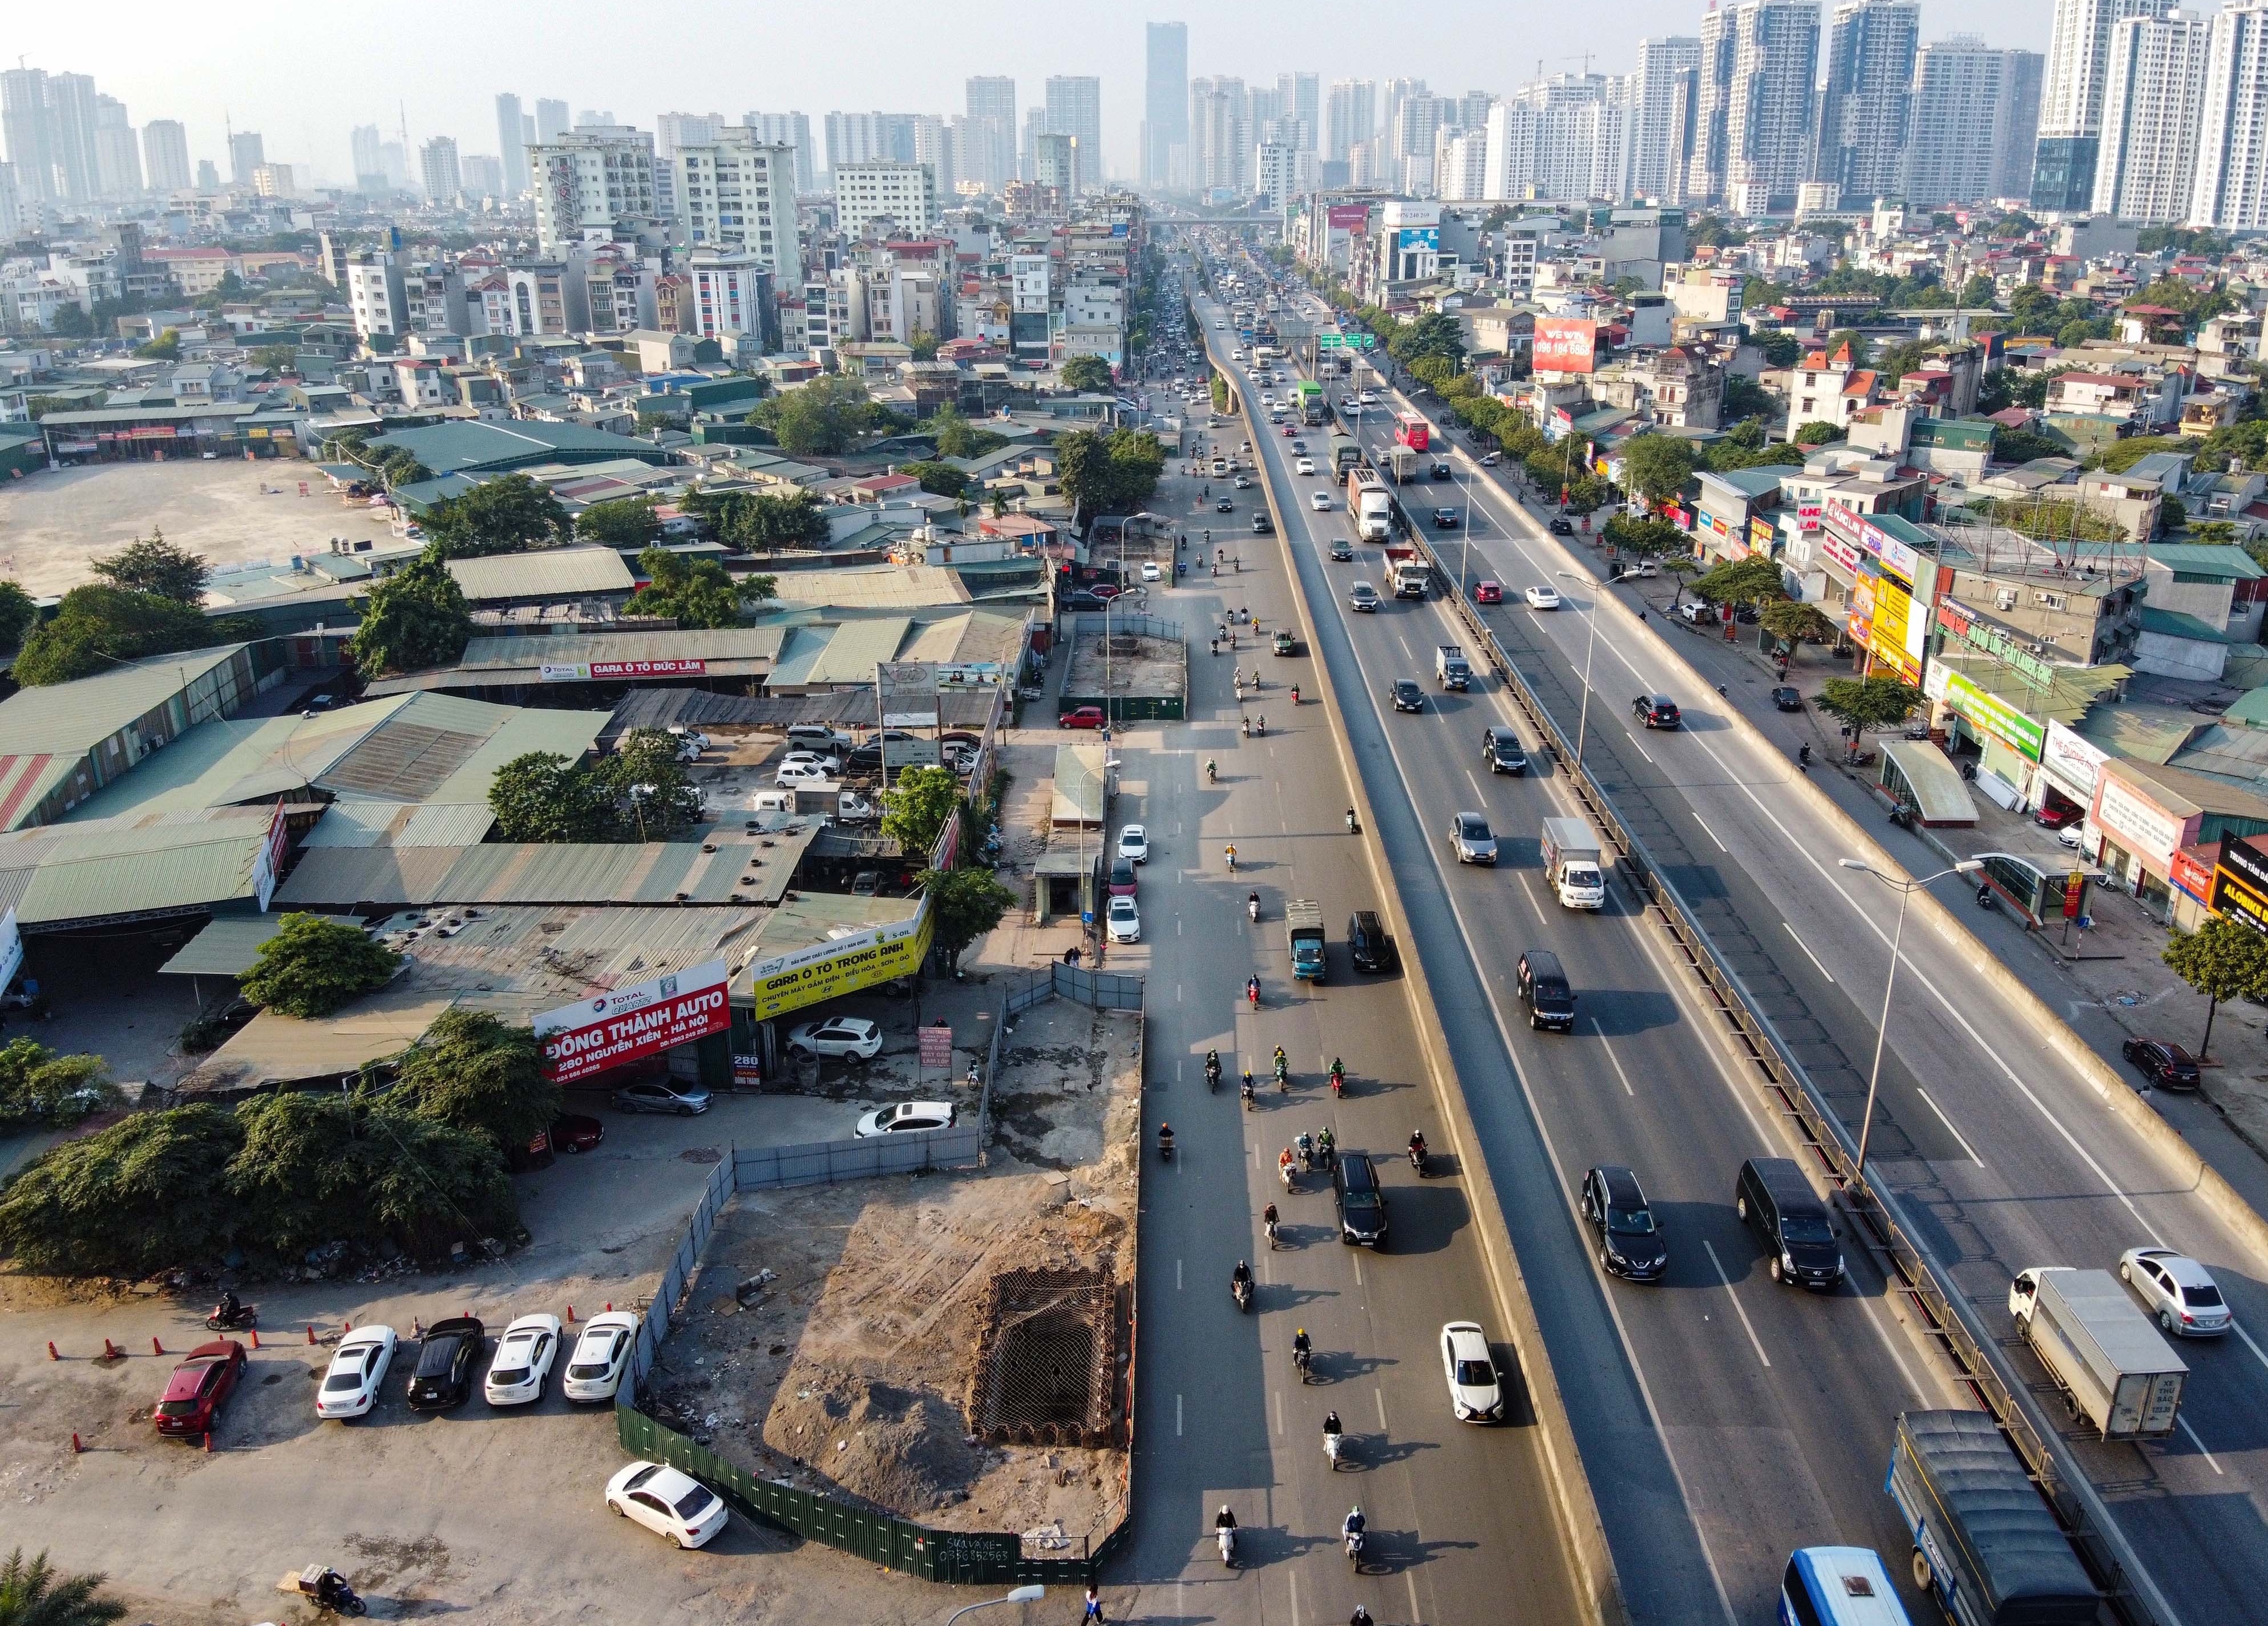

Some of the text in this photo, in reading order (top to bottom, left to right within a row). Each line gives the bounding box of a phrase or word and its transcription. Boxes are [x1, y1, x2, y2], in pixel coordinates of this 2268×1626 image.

[1546, 330, 1584, 340] WE WIN
[1537, 342, 1590, 355] 096 184 6868
[593, 660, 701, 673] GARA Ô TÔ ĐỨC LÂM
[2229, 850, 2247, 868] TRUNG
[2248, 861, 2259, 878] TÂM
[2223, 883, 2262, 918] ALOBIKE
[892, 929, 911, 939] S-OIL
[766, 942, 904, 990] GARA Ô TÔ TRỌNG ANH
[762, 990, 789, 1003] CHUYÊN
[791, 985, 806, 994] MÁY
[861, 964, 875, 973] HÒA
[880, 958, 894, 967] SƠN
[611, 990, 645, 1005] TOTAL
[611, 996, 652, 1015] QUARTZ
[545, 990, 723, 1061] ĐÔNG THÀNH AUTO
[558, 1057, 584, 1073] 280
[586, 1038, 633, 1063] NGUYỄN
[671, 1020, 686, 1034] HÀ
[689, 1014, 709, 1029] NỘI
[670, 1034, 685, 1044] 0903
[685, 1031, 697, 1040] 249
[734, 1055, 758, 1065] 280
[556, 1074, 568, 1083] 024
[581, 1063, 600, 1076] 40265
